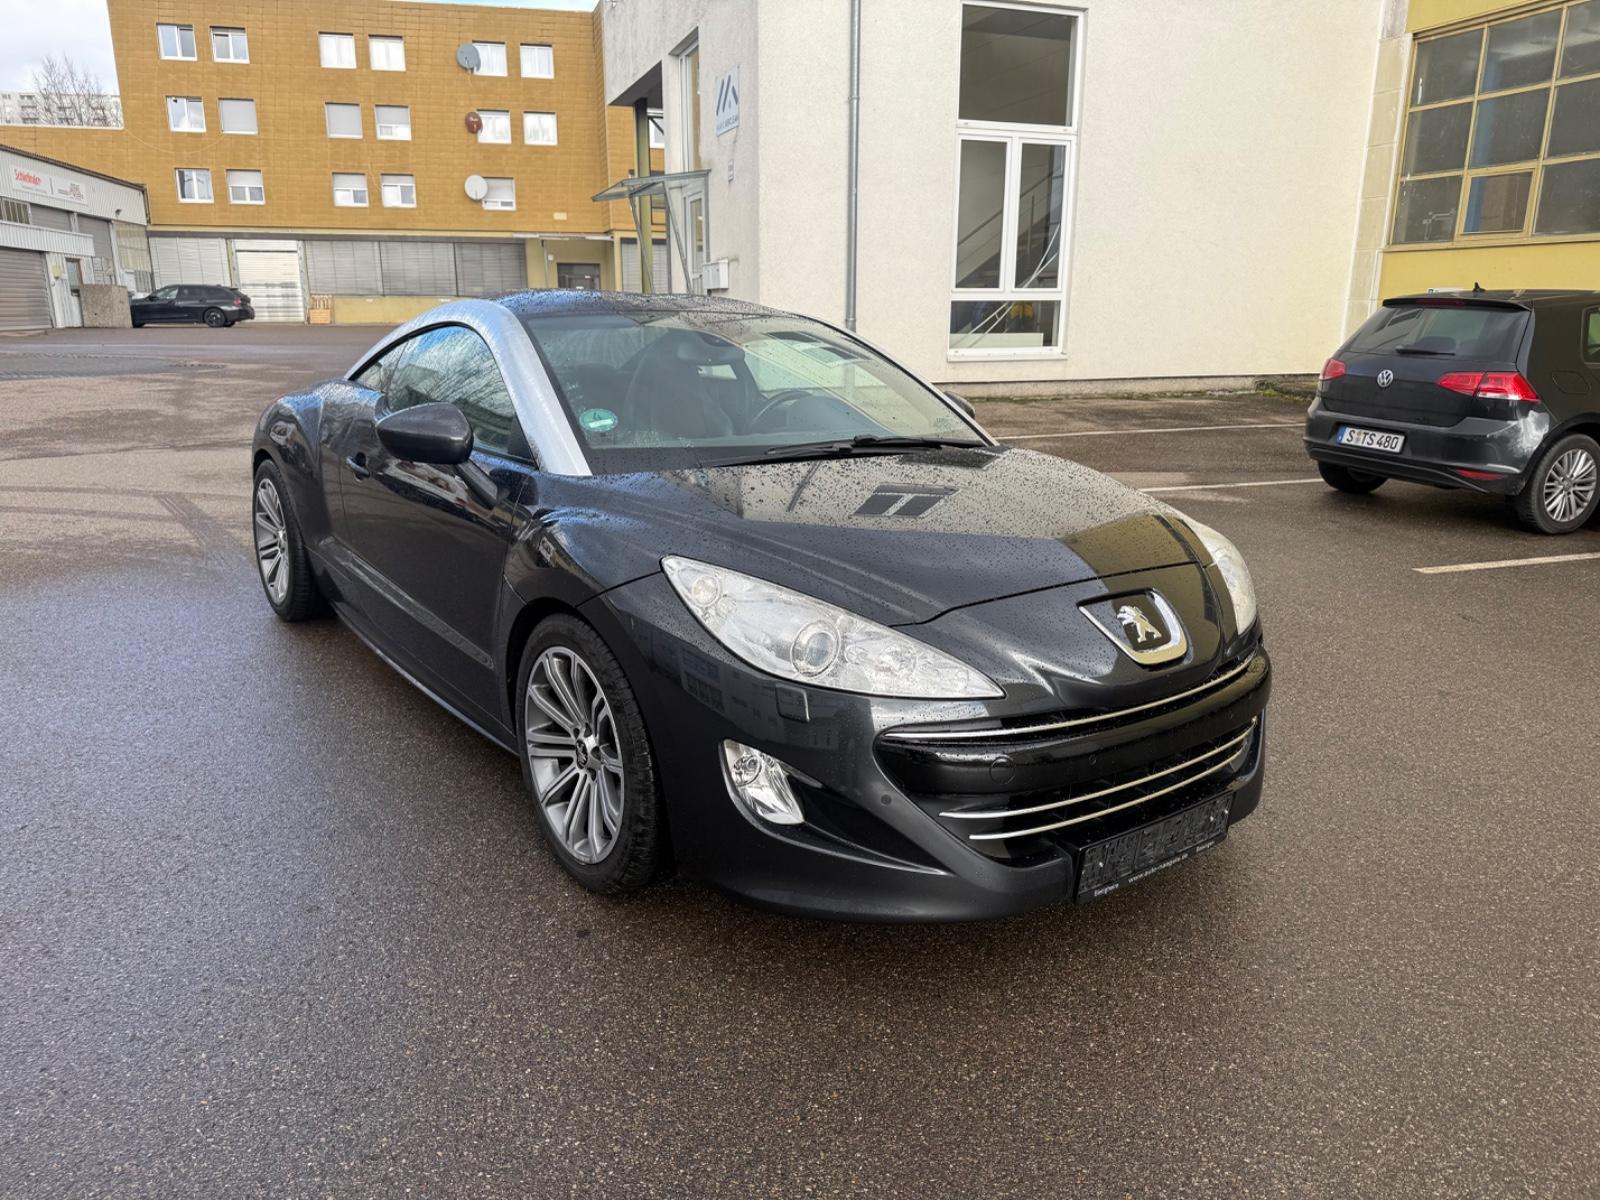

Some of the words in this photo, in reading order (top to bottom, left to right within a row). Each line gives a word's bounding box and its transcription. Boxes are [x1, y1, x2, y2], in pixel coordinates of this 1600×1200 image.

[1346, 430, 1356, 443] S
[1361, 431, 1377, 446] TS
[1377, 435, 1399, 450] 480
